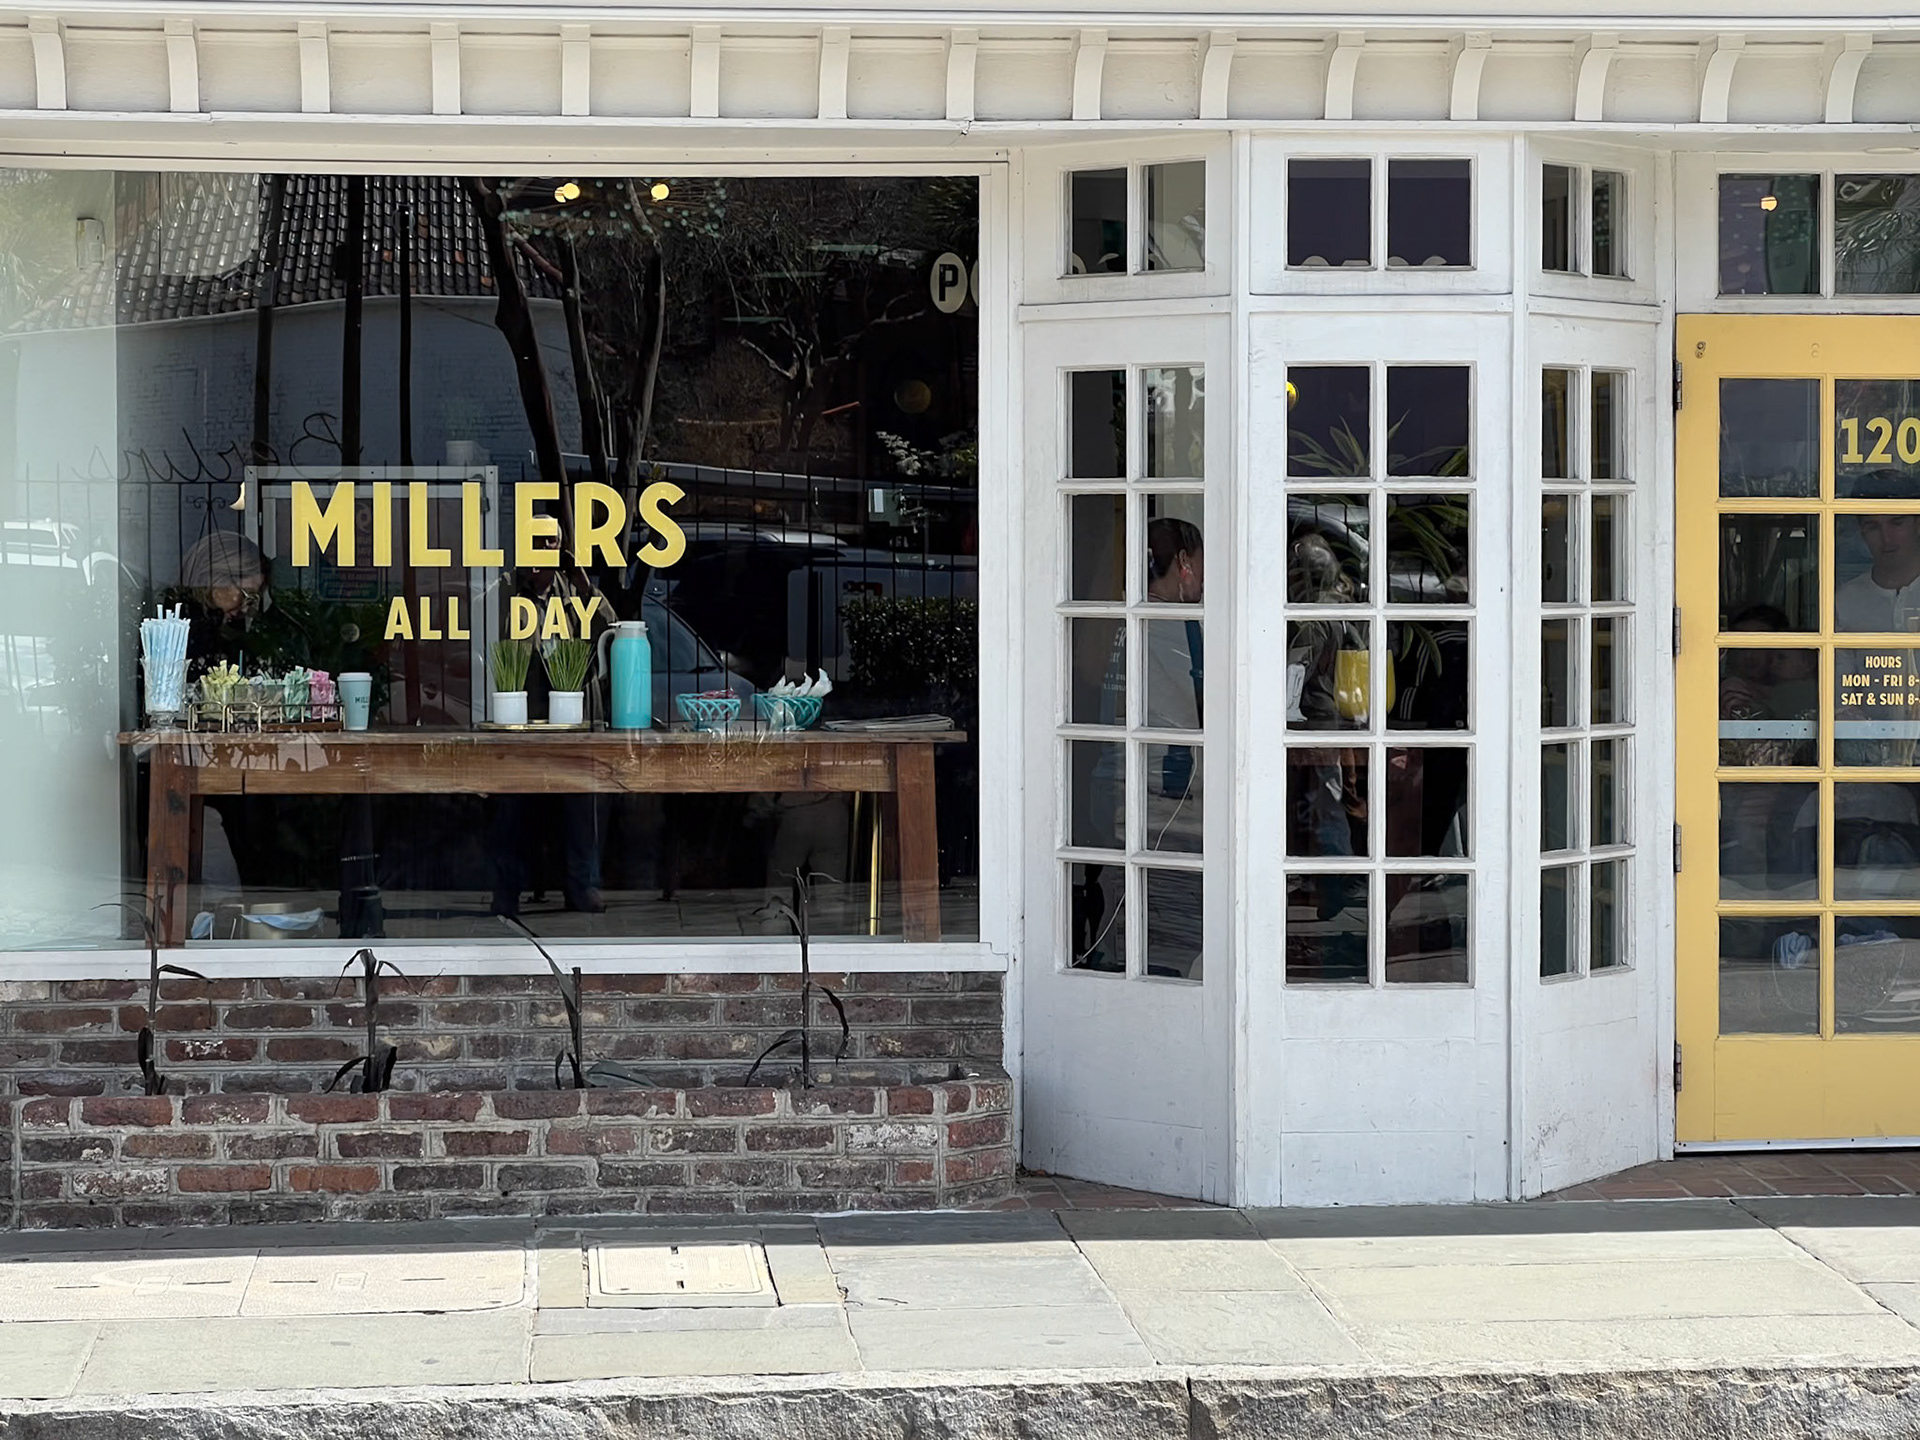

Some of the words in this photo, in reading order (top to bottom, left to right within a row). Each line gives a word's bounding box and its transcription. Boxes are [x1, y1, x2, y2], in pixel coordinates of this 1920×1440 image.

[1841, 417, 1920, 464] 120
[291, 481, 687, 568] MILLERS
[385, 596, 470, 640] ALL
[510, 596, 601, 640] DAY
[1865, 656, 1902, 669] HOURS
[1842, 674, 1870, 687] MON
[1883, 674, 1903, 687] FRI
[1841, 693, 1864, 706] SAT
[1866, 693, 1876, 706] &
[1879, 693, 1904, 706] SUN
